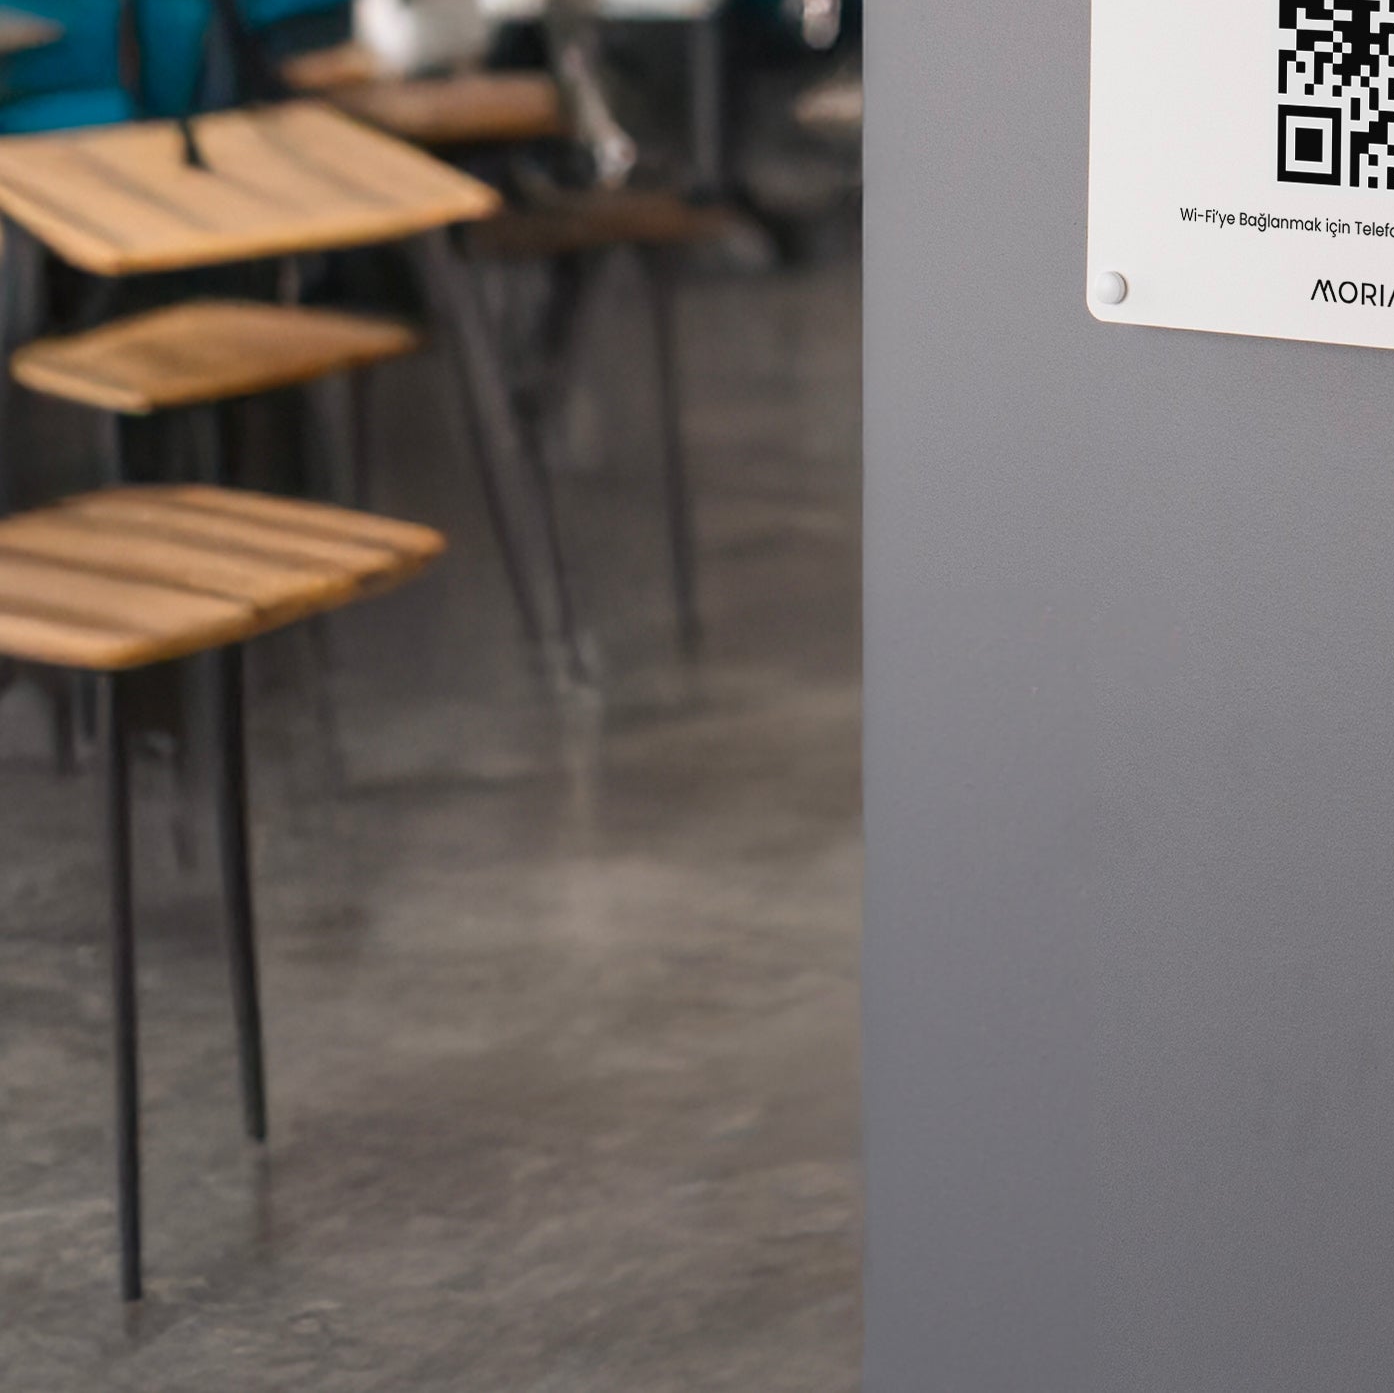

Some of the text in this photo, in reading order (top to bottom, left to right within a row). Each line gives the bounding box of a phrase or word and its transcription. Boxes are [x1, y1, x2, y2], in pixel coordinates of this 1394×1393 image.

[1179, 207, 1236, 229] Wi-Fi'ye
[1239, 211, 1322, 233] Bağlanmak
[1325, 217, 1351, 239] için
